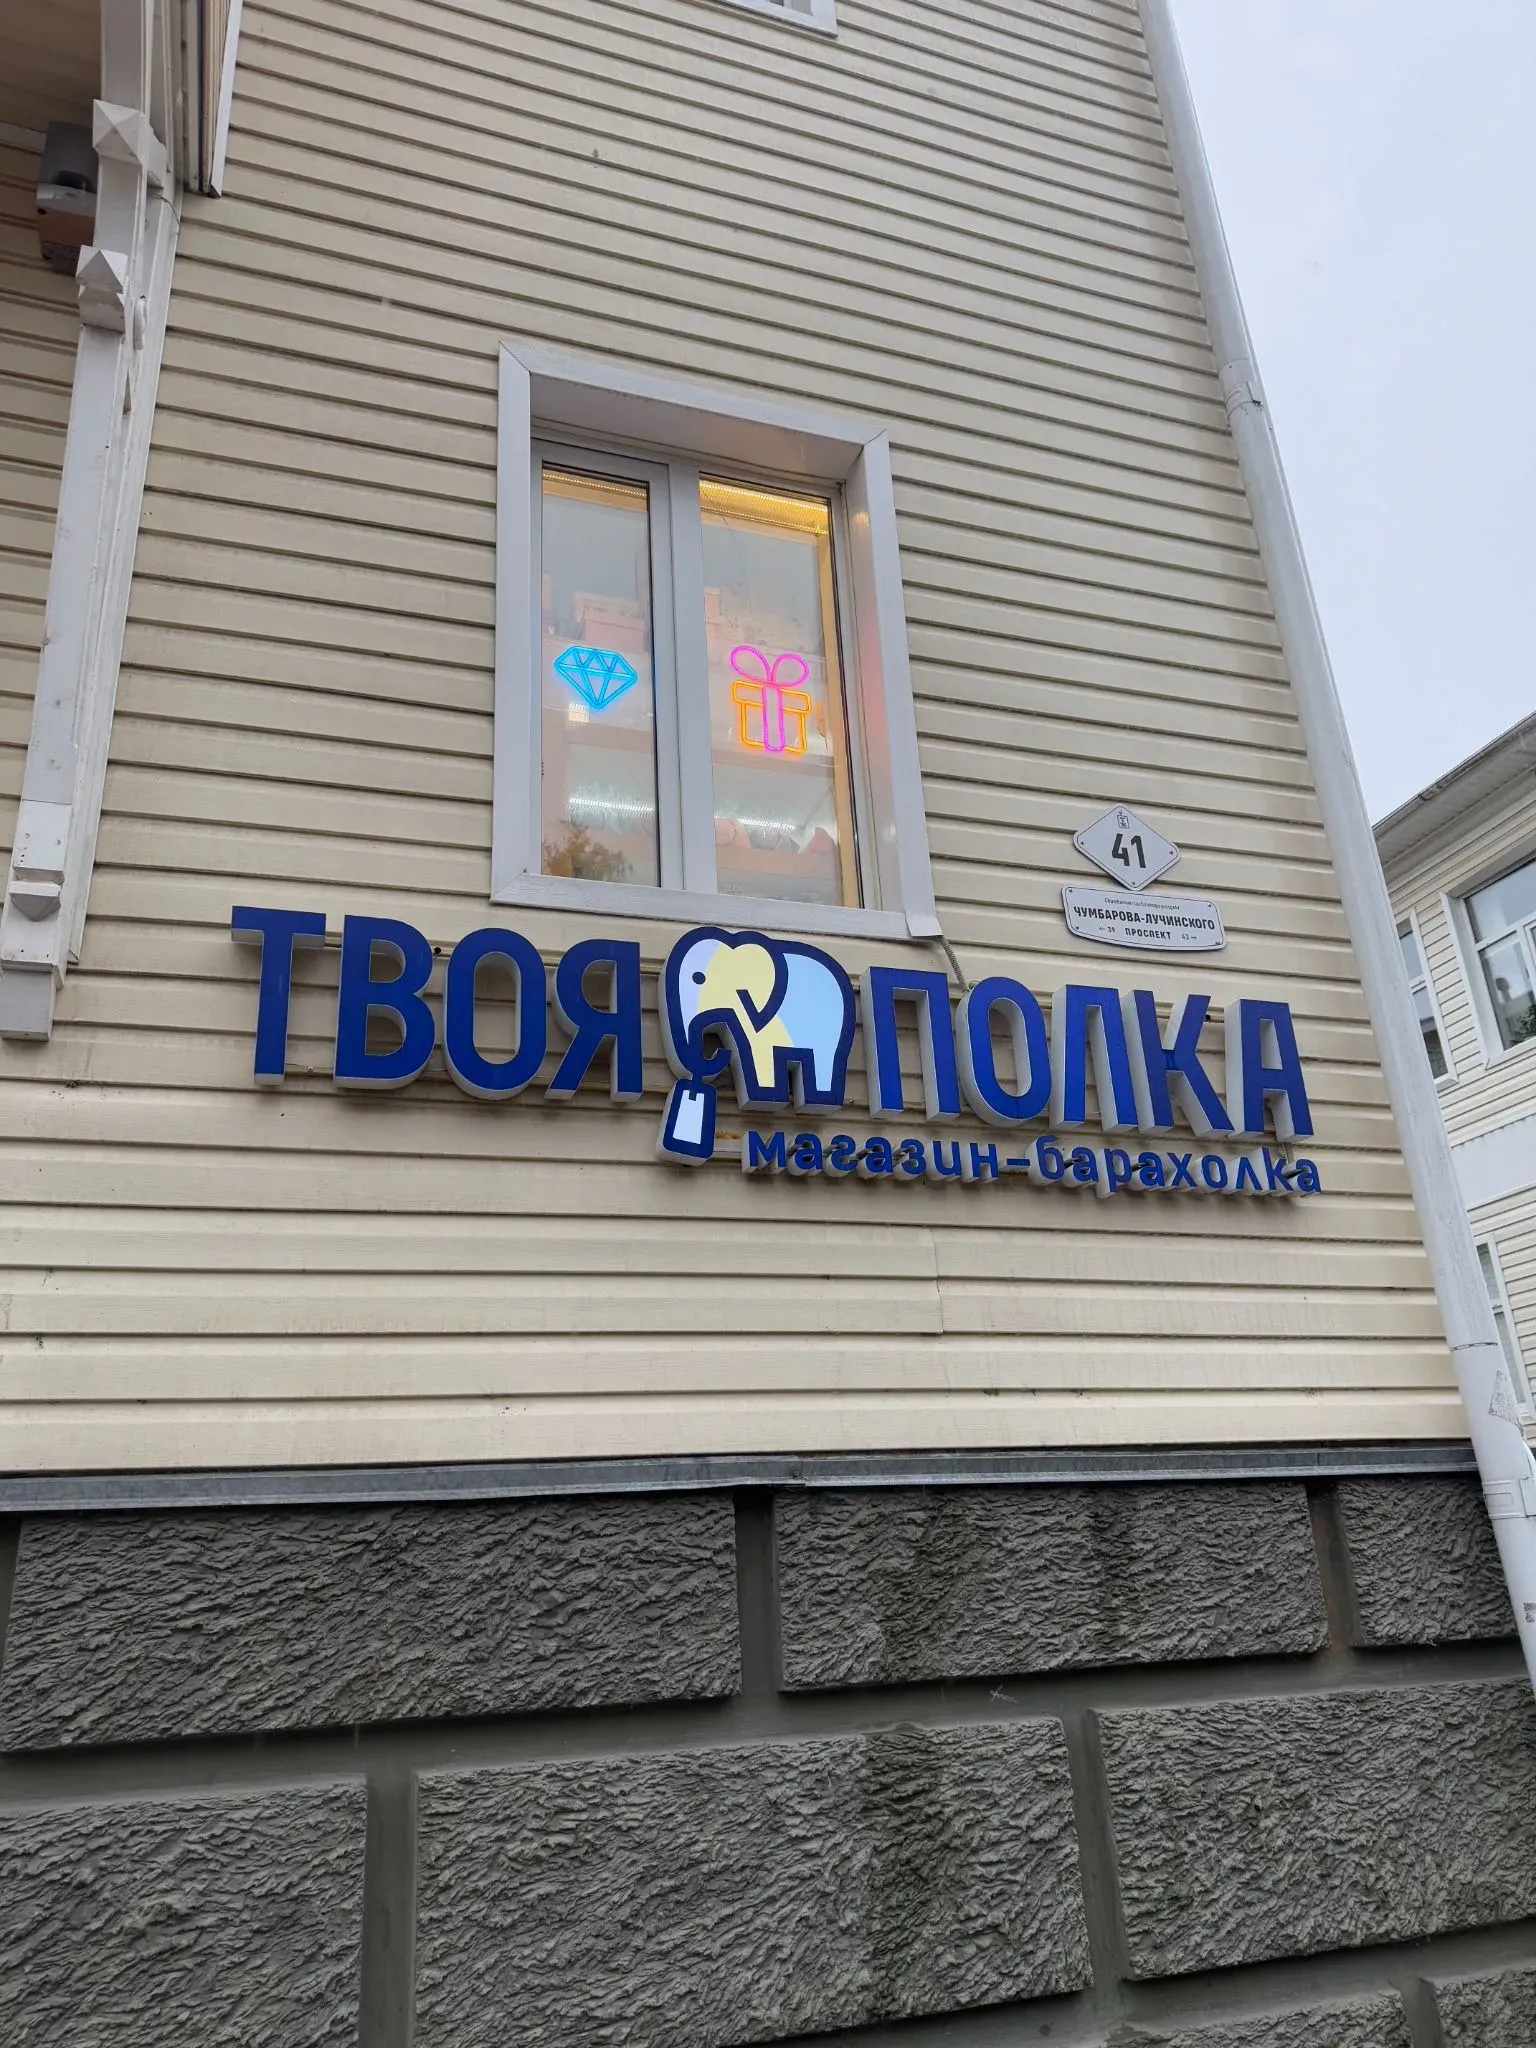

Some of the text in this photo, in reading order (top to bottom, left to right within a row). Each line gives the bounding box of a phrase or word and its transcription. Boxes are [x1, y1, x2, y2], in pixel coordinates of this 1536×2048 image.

[1111, 832, 1147, 869] 41
[1073, 905, 1215, 930] ЧУМБАРОВА-ЛУЧИНСКОГО
[1124, 927, 1171, 940] ПРОСПЕКТ
[231, 905, 1315, 1140] ТВОЯ ПОЛКА
